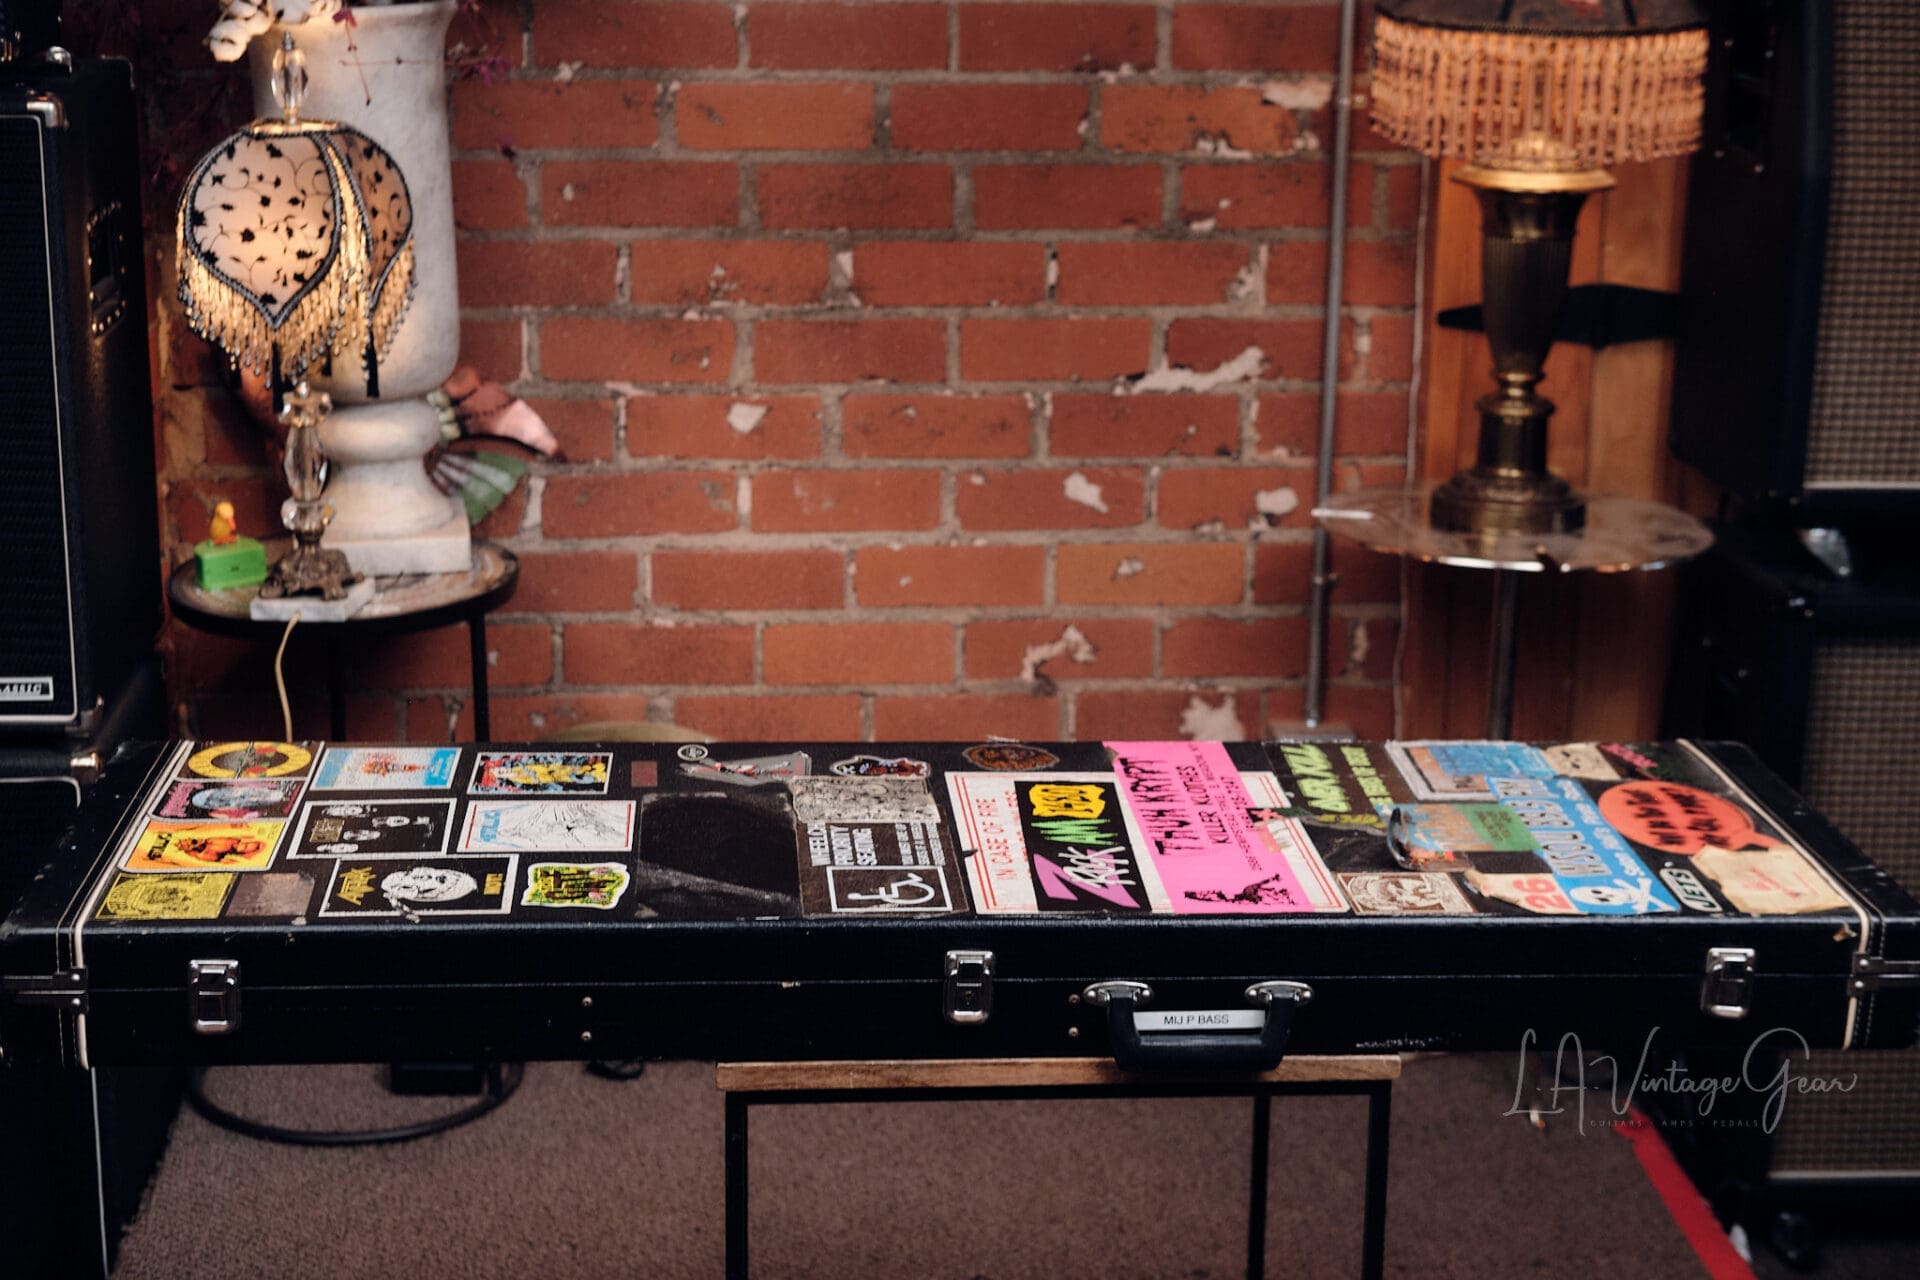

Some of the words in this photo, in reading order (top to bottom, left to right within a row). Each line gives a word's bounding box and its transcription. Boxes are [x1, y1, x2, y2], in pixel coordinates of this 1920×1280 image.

[1118, 758, 1176, 802] KRYPT
[1176, 766, 1210, 804] KLOTHES
[975, 798, 998, 816] FIRE
[982, 822, 1005, 833] OF
[1031, 818, 1118, 845] AM
[1139, 809, 1204, 854] THUH
[1198, 811, 1229, 843] KILLER
[807, 822, 831, 866] WHEELCH
[830, 825, 854, 866] PRIORITY
[853, 828, 878, 866] SEATING
[986, 838, 1014, 863] CASE
[995, 868, 1017, 879] IN
[1668, 869, 1714, 909] JETS
[1511, 878, 1574, 909] 26
[1164, 1015, 1183, 1024] MIJ
[1187, 1015, 1194, 1024] P
[1198, 1014, 1229, 1024] BASS
